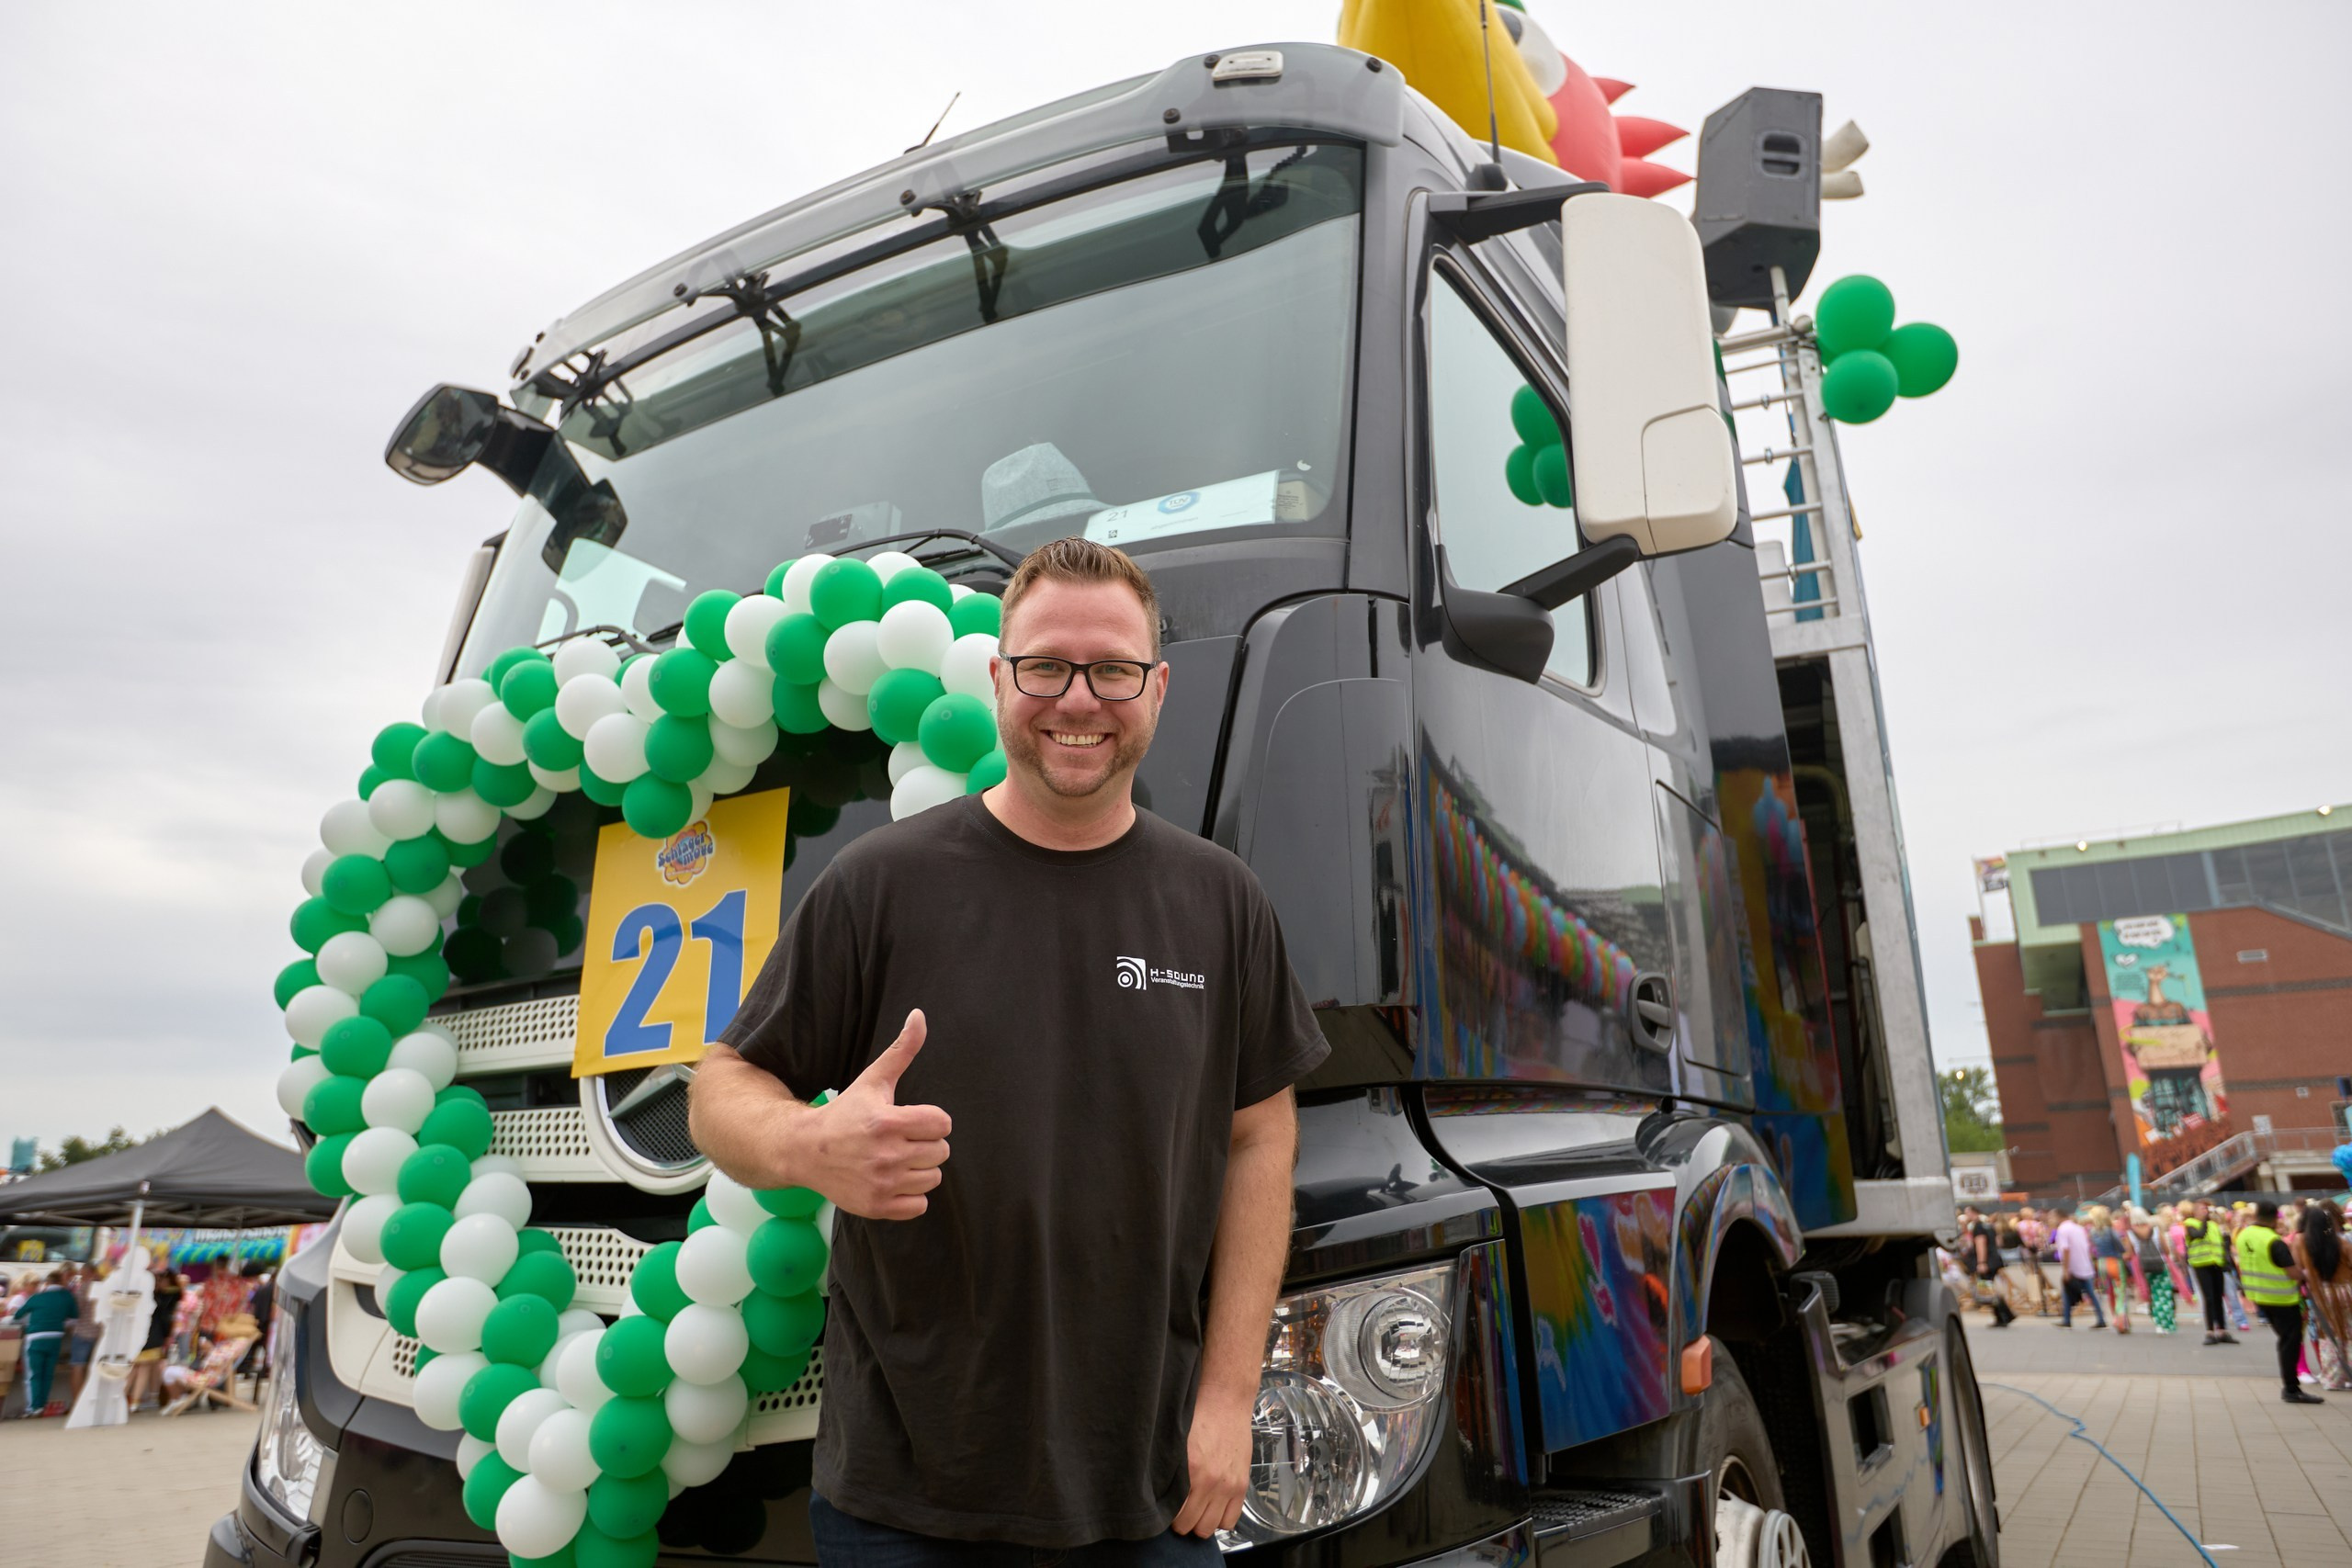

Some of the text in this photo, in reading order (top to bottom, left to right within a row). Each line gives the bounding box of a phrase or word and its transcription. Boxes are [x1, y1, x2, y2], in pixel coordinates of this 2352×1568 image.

[1106, 509, 1129, 523] 21
[658, 832, 707, 867] Schlager
[604, 888, 747, 1058] 21
[1150, 968, 1204, 983] H-SOUND
[1150, 976, 1204, 989] Veranstaltungstechnik
